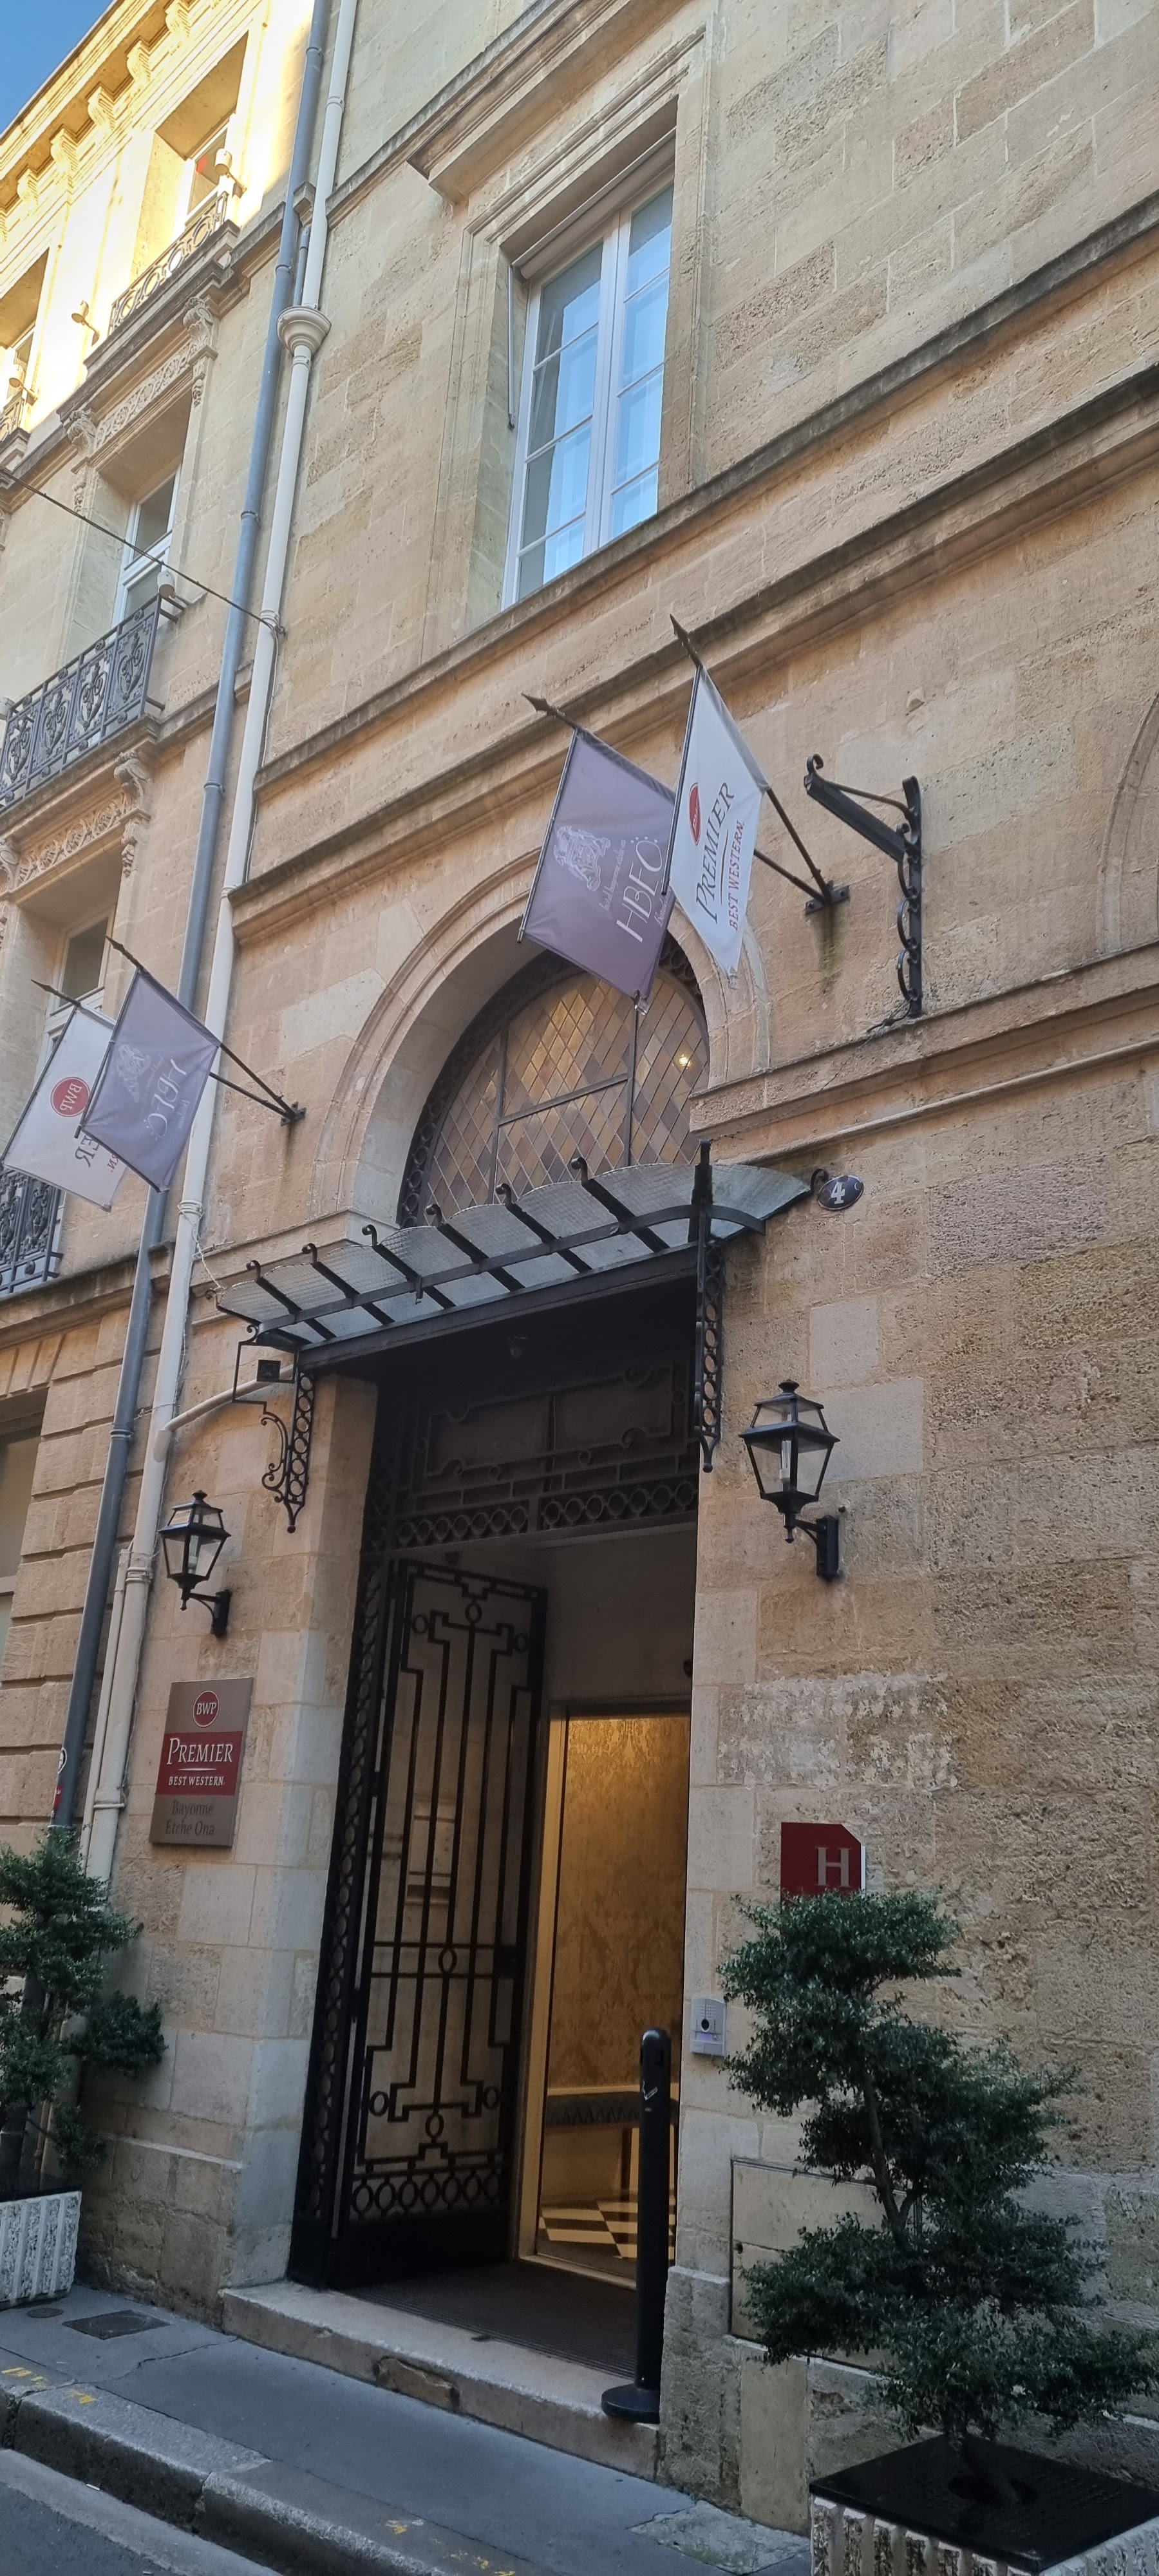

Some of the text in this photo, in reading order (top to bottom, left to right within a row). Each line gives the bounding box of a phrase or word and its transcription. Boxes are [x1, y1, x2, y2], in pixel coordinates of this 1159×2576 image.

[696, 782, 735, 923] PREMIER
[728, 893, 739, 932] BEST
[831, 1181, 845, 1204] 4
[196, 1702, 217, 1716] BWP
[167, 1738, 234, 1765] PREMIER
[169, 1776, 224, 1786] BEST WESTERN
[171, 1799, 214, 1821] Bayonne
[165, 1820, 215, 1836] Etche Ona
[815, 1846, 853, 1887] H
